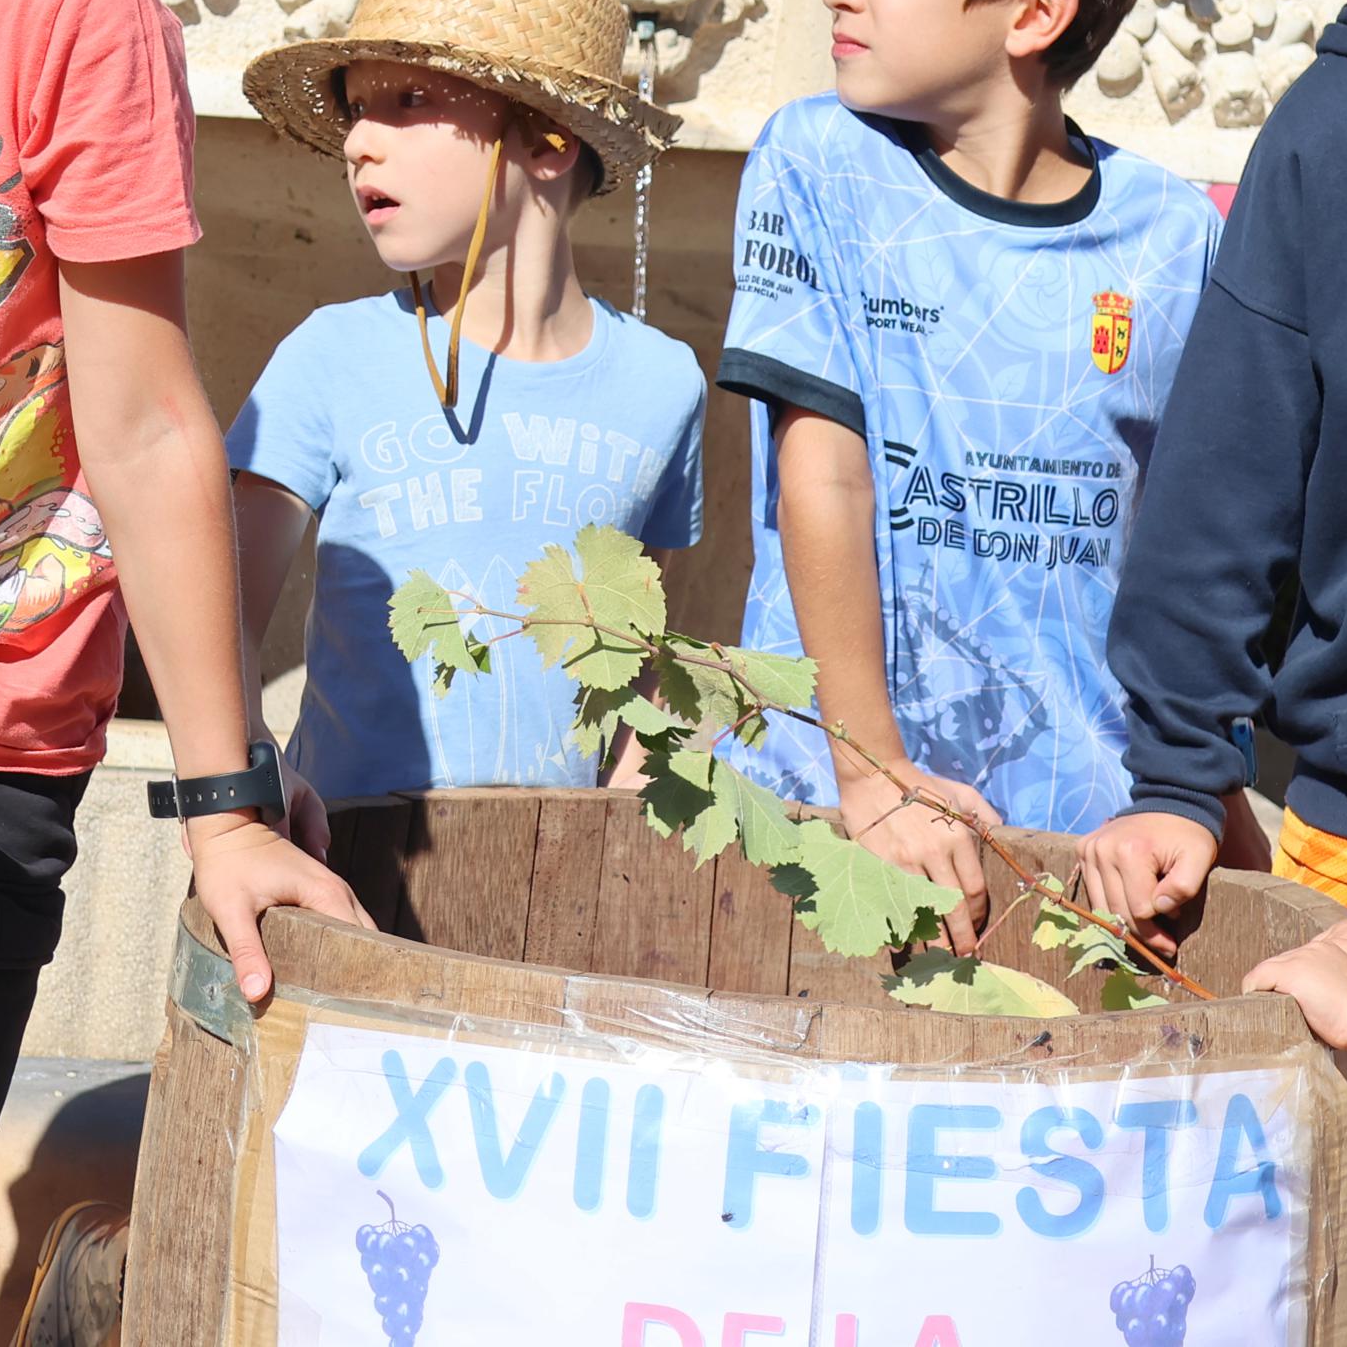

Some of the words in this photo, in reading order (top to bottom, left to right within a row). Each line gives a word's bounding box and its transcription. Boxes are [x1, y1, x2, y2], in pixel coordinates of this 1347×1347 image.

[748, 210, 784, 237] BAR
[737, 285, 779, 301] ALENCIA)
[360, 414, 470, 474] GO
[965, 451, 1103, 478] AYUNTAMIENTO
[1105, 461, 1122, 478] DE
[360, 468, 483, 539] THE
[512, 470, 633, 529] FLO
[917, 516, 966, 550] DE
[973, 528, 1039, 562] DON
[1046, 534, 1111, 570] JUAN
[356, 1048, 667, 1222] XVII
[720, 1090, 1284, 1240] FIESTA
